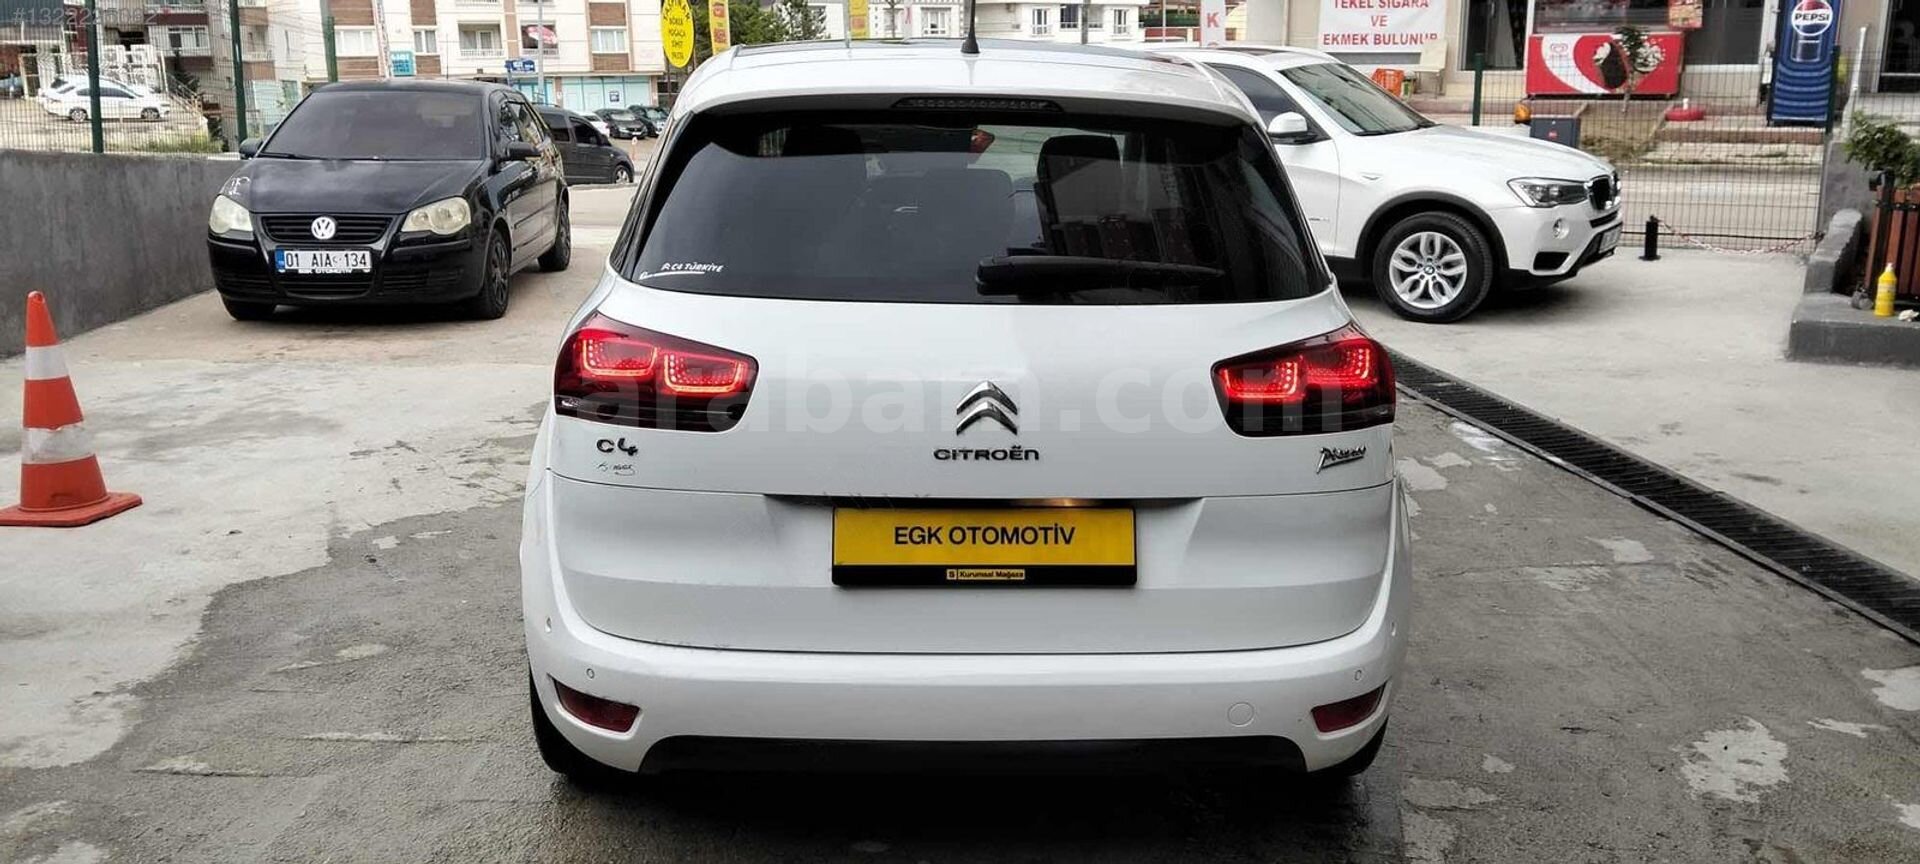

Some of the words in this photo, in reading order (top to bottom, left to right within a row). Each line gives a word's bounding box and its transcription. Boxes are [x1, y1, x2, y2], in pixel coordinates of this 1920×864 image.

[1370, 15, 1388, 27] VE
[1794, 13, 1830, 21] PEPSI
[1323, 33, 1368, 45] EKMEK
[286, 253, 299, 267] 01
[344, 253, 367, 267] 134
[596, 437, 639, 457] C4
[894, 526, 942, 545] EGK
[948, 522, 1075, 545] OTOMOTİV
[960, 570, 994, 578] Kurumsal
